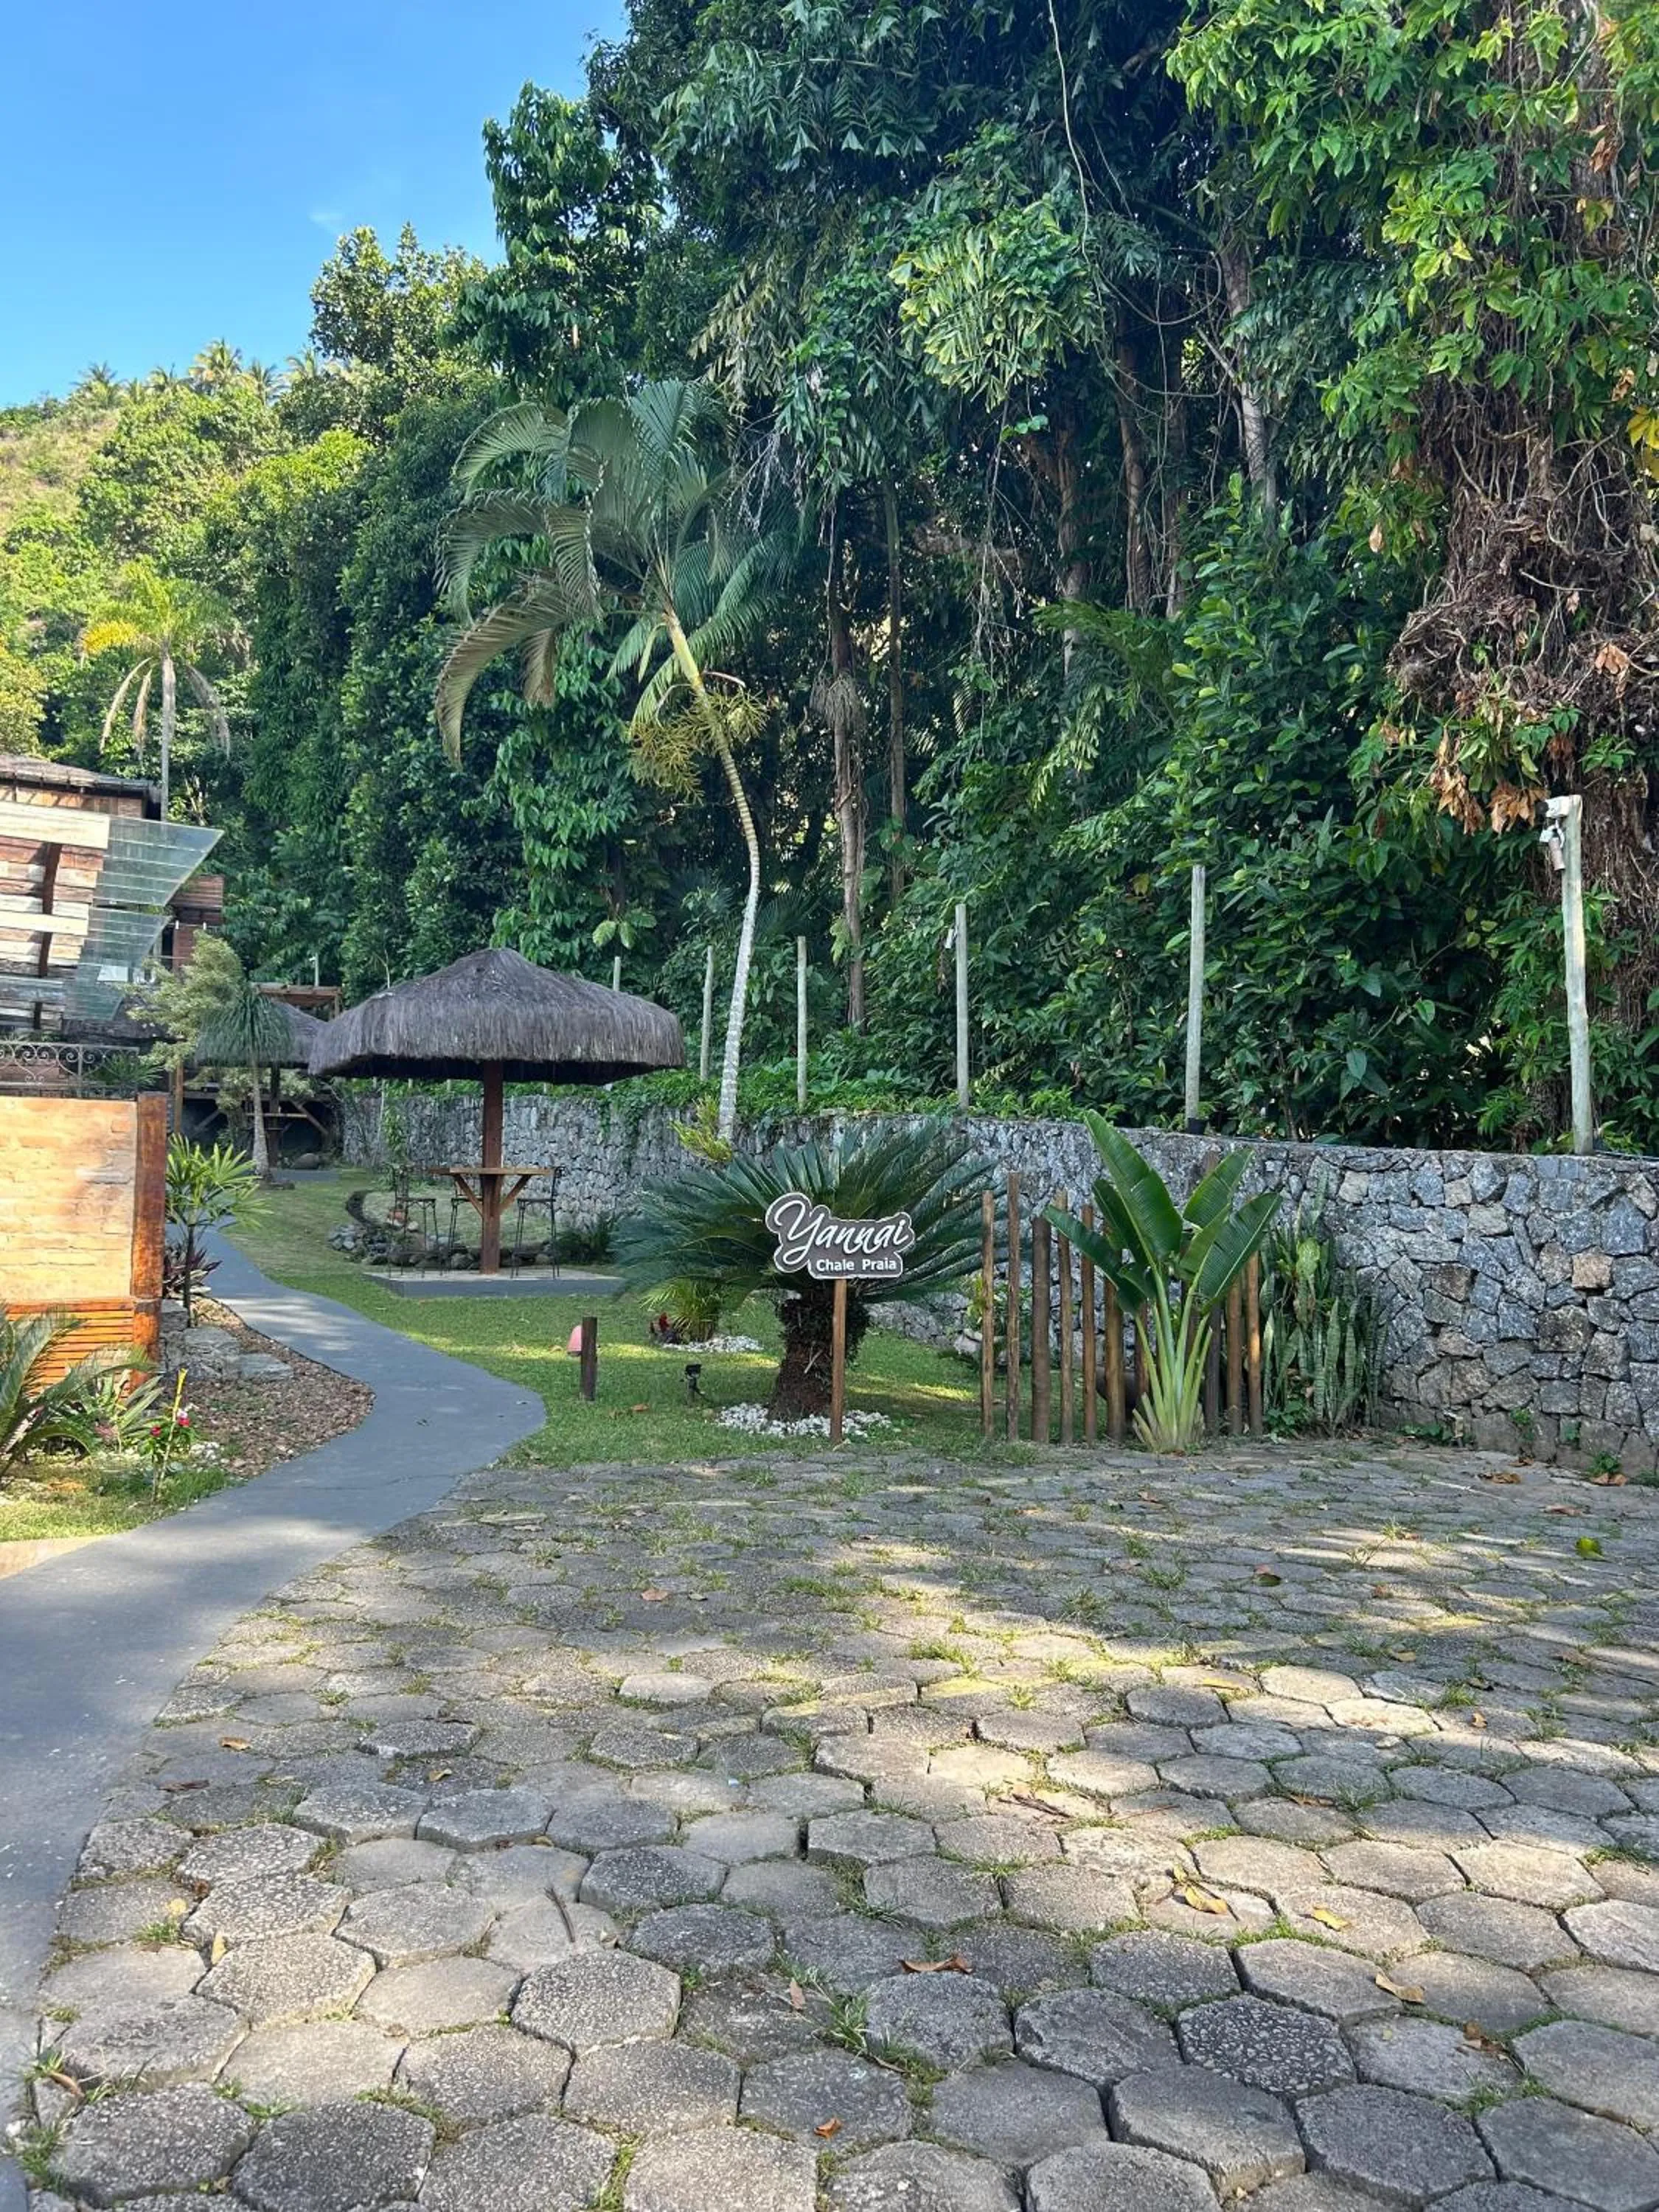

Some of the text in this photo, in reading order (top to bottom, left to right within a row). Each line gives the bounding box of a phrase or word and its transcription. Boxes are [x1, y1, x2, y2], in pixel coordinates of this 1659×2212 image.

[774, 1200, 909, 1265] Yannai
[815, 1257, 897, 1272] Chale Praia
